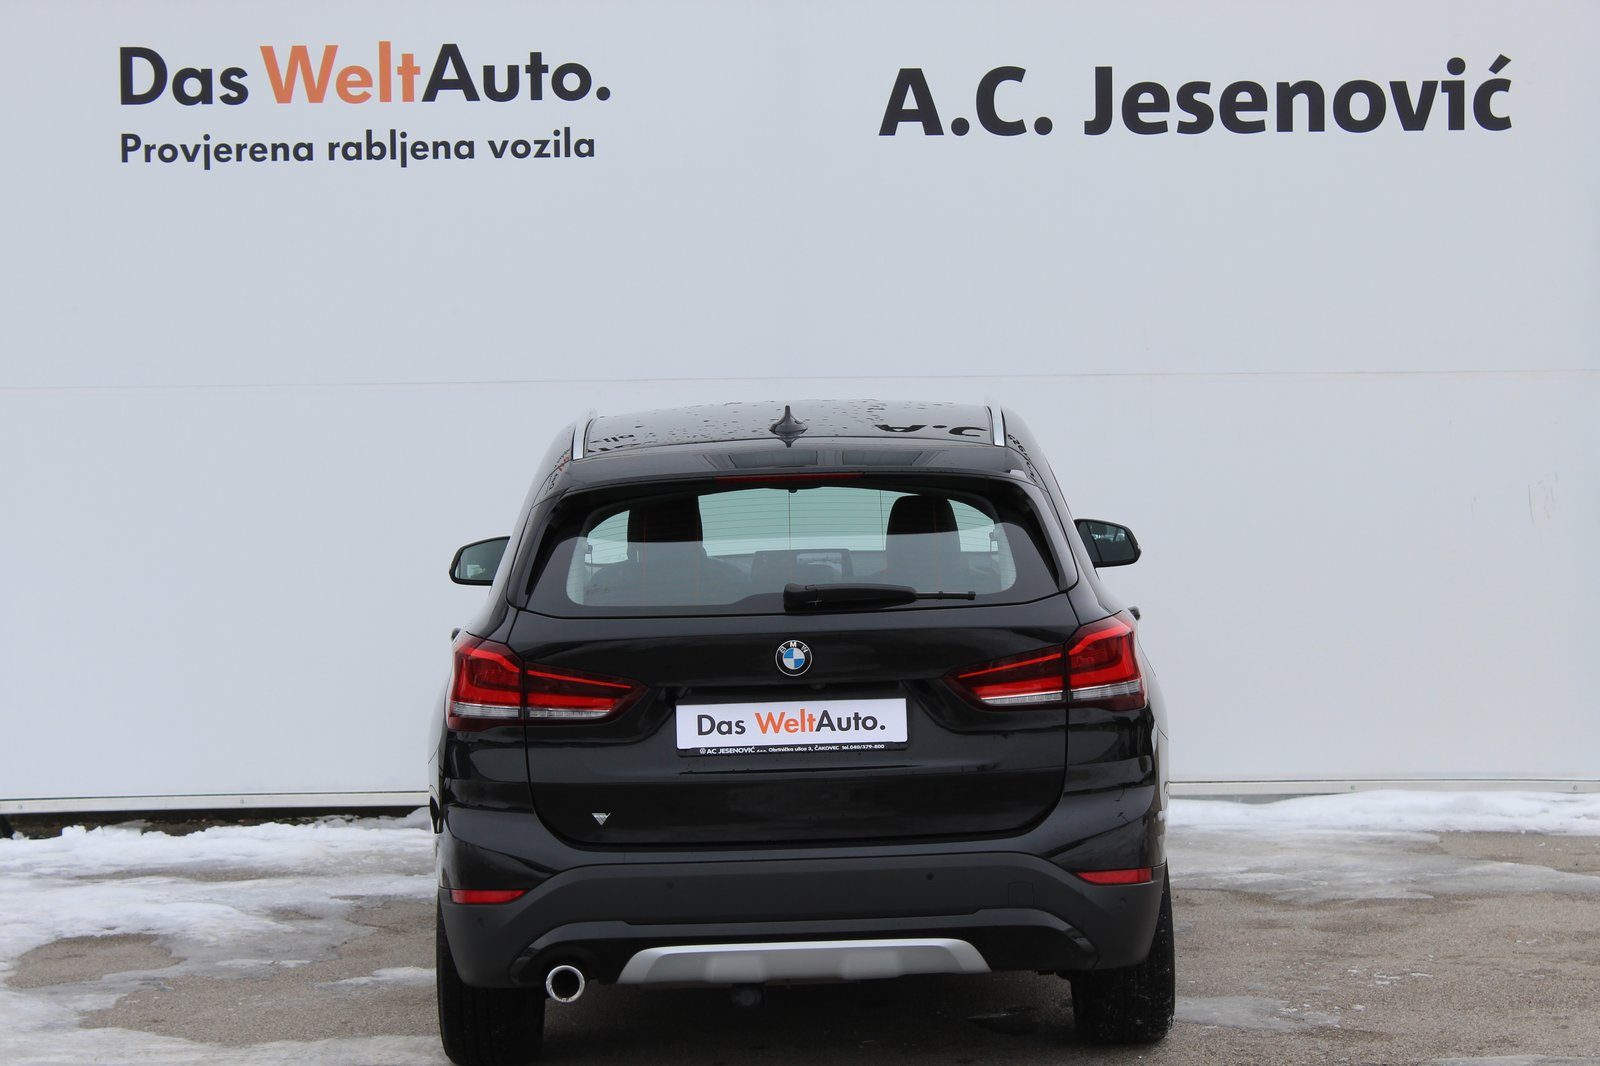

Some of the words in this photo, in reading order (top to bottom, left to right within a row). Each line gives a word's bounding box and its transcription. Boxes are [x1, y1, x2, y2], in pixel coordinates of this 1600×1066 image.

[119, 46, 249, 107] Das
[260, 40, 611, 105] WeltAuto.
[878, 65, 1053, 137] A.C.
[1083, 53, 1513, 136] Jesenović
[120, 133, 314, 171] Provjerena
[328, 128, 475, 169] rabljena
[487, 126, 595, 159] vozila
[779, 641, 809, 653] BMW
[697, 714, 746, 736] Das
[755, 708, 886, 735] WeltAuto.
[718, 745, 756, 754] JESENOVIĆ
